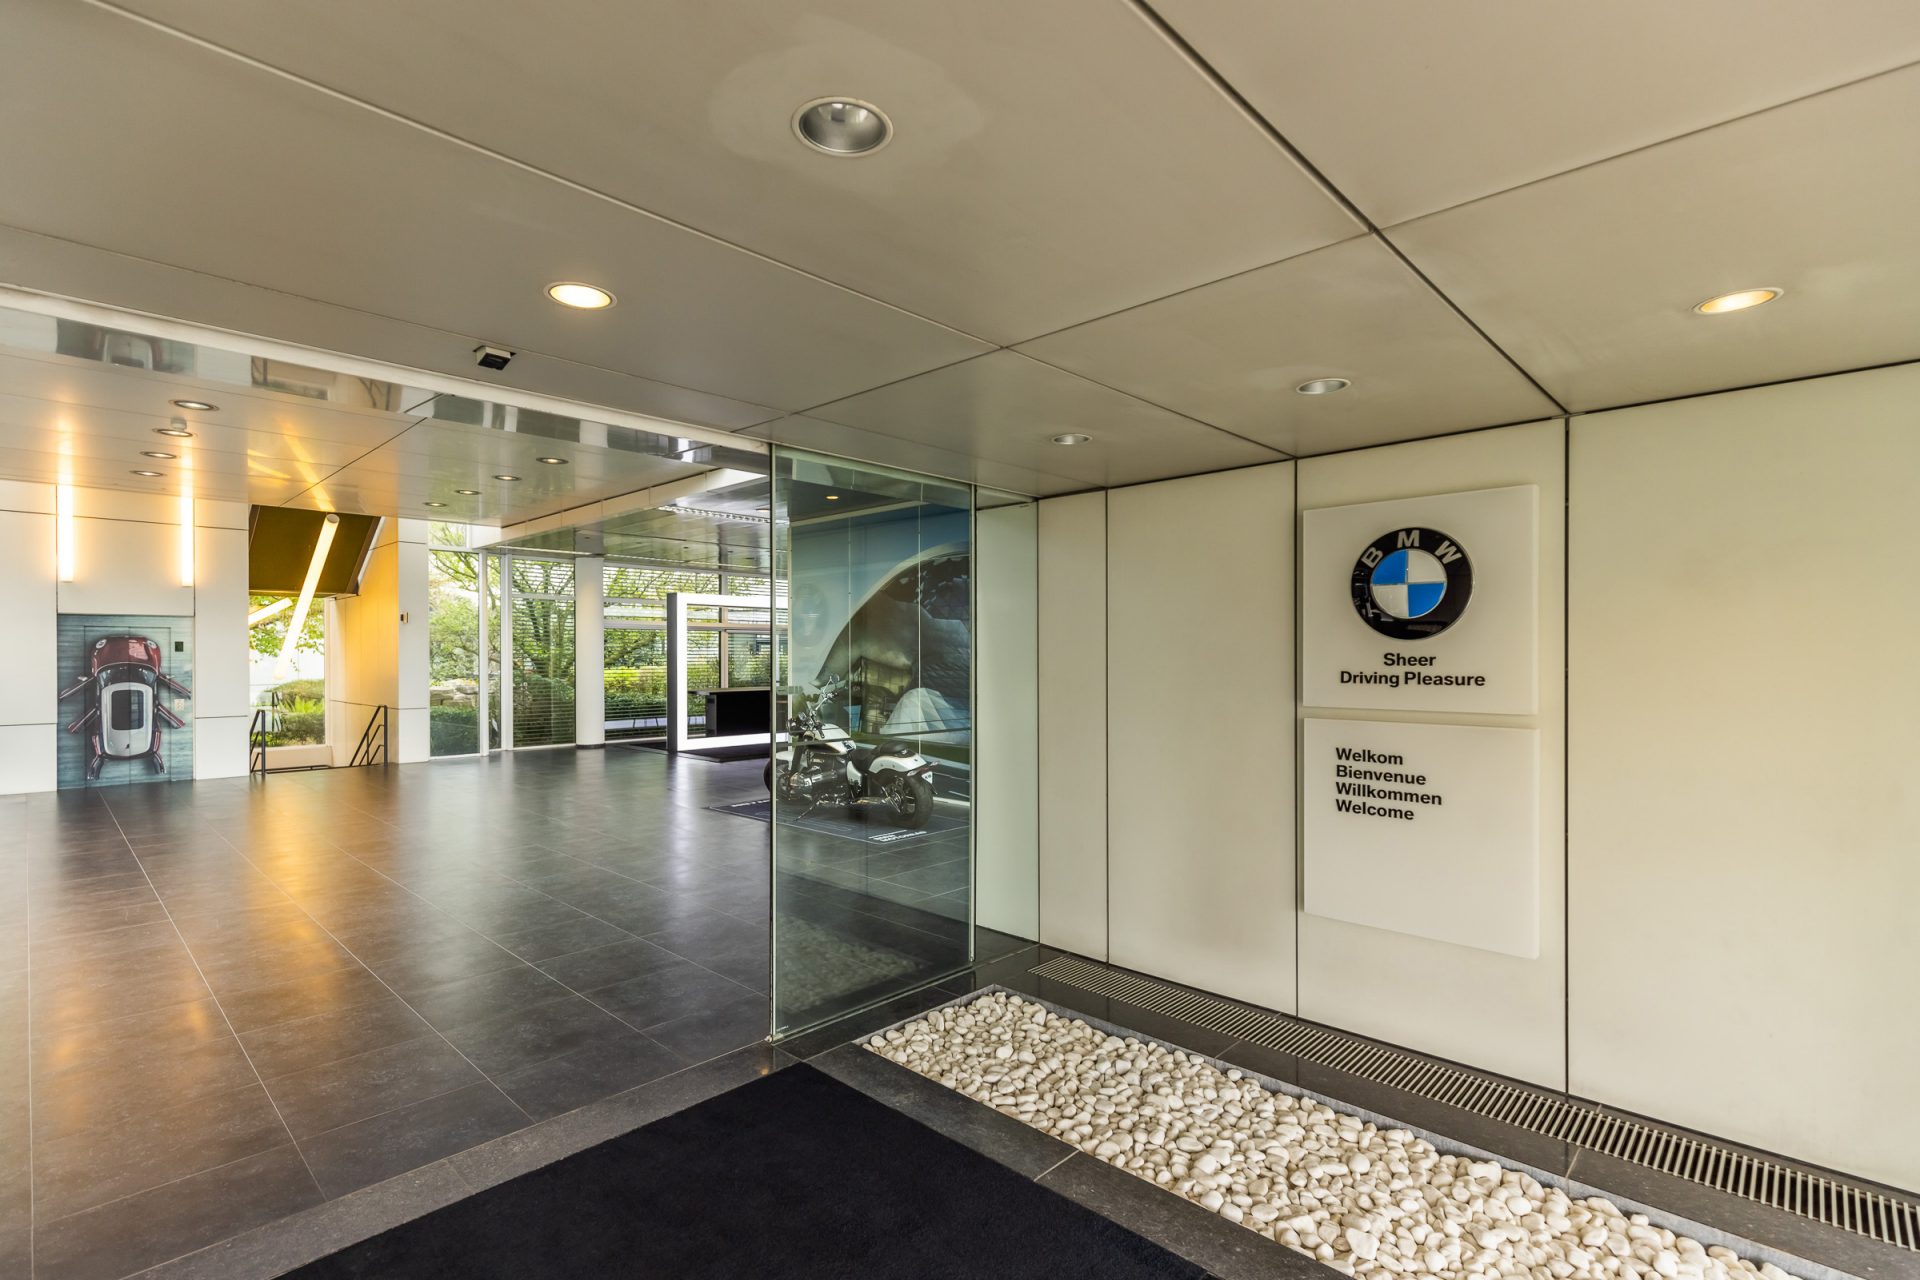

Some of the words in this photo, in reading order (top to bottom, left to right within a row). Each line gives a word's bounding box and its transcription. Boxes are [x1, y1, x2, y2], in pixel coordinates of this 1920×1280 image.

[1361, 530, 1462, 569] BMW
[1383, 653, 1436, 666] Sheer
[1340, 671, 1399, 688] Driving
[1404, 671, 1486, 686] Pleasure
[1336, 747, 1403, 766] Welkom
[1336, 764, 1427, 785] Bienvenue
[1336, 782, 1442, 805] Willkommen
[1336, 799, 1414, 820] Welcome
